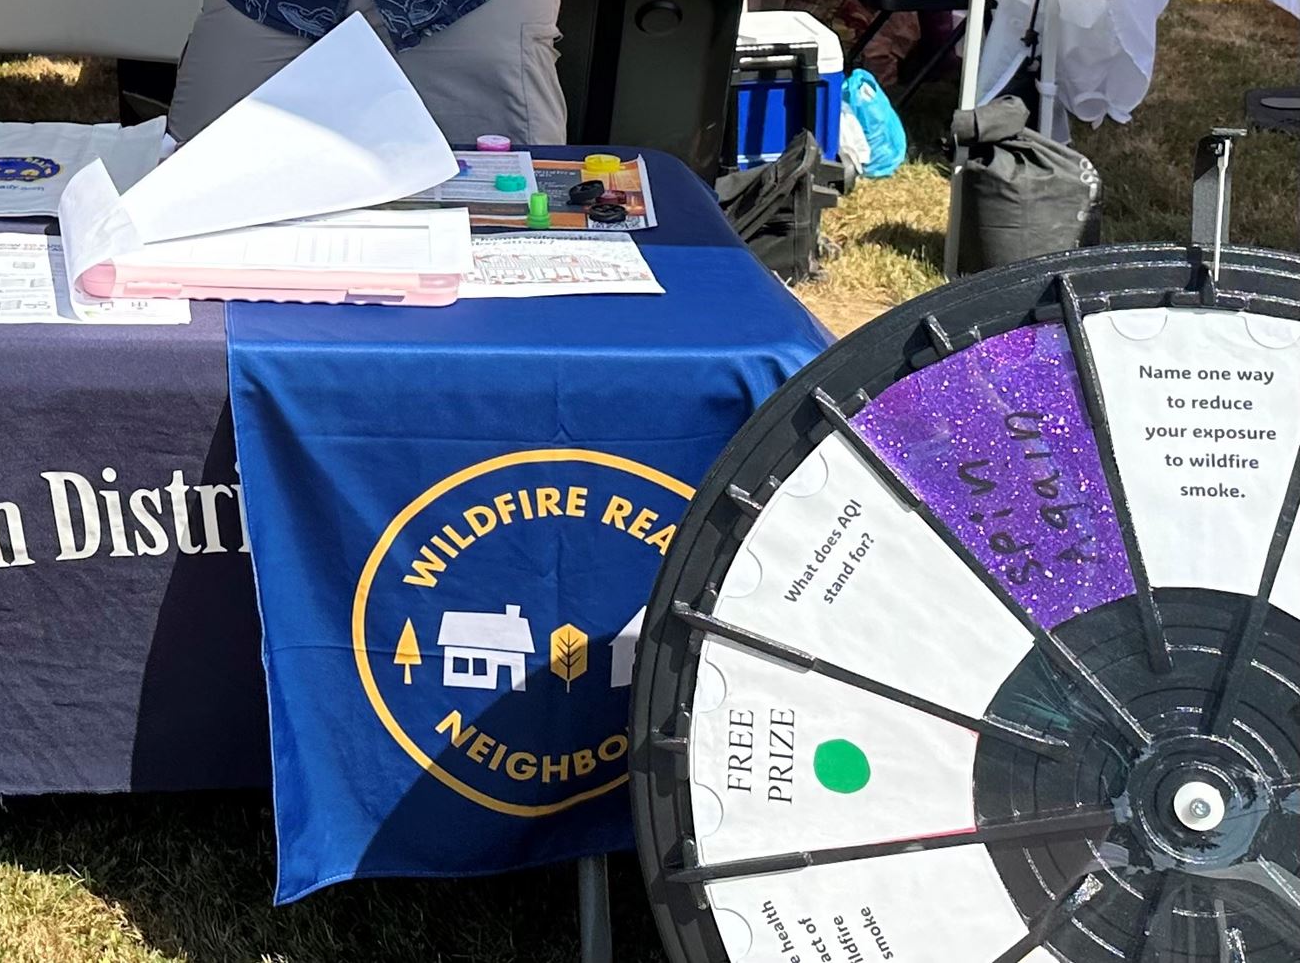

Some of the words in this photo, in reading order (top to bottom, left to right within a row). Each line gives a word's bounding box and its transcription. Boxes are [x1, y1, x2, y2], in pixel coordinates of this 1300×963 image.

[1139, 365, 1191, 380] Name
[1197, 369, 1231, 381] one
[1237, 370, 1274, 385] way
[1167, 395, 1186, 409] to
[1191, 395, 1253, 410] reduce
[1145, 426, 1187, 441] your
[1192, 427, 1277, 443] exposure
[1165, 453, 1184, 467] to
[1189, 453, 1260, 469] wildfire
[41, 466, 253, 563] Distri
[1180, 483, 1246, 498] smoke.
[402, 485, 588, 588] WILDFIRE
[601, 494, 677, 556] REA
[784, 564, 819, 602] What
[813, 529, 842, 564] does
[837, 499, 862, 529] AQI
[823, 561, 855, 605] stand
[848, 532, 875, 563] for?
[434, 709, 629, 784] NEIGHBO
[727, 709, 754, 793] FREE
[768, 708, 795, 805] PRIZE
[761, 900, 795, 954] health
[797, 917, 817, 935] of
[811, 937, 832, 963] act
[860, 906, 894, 960] smoke
